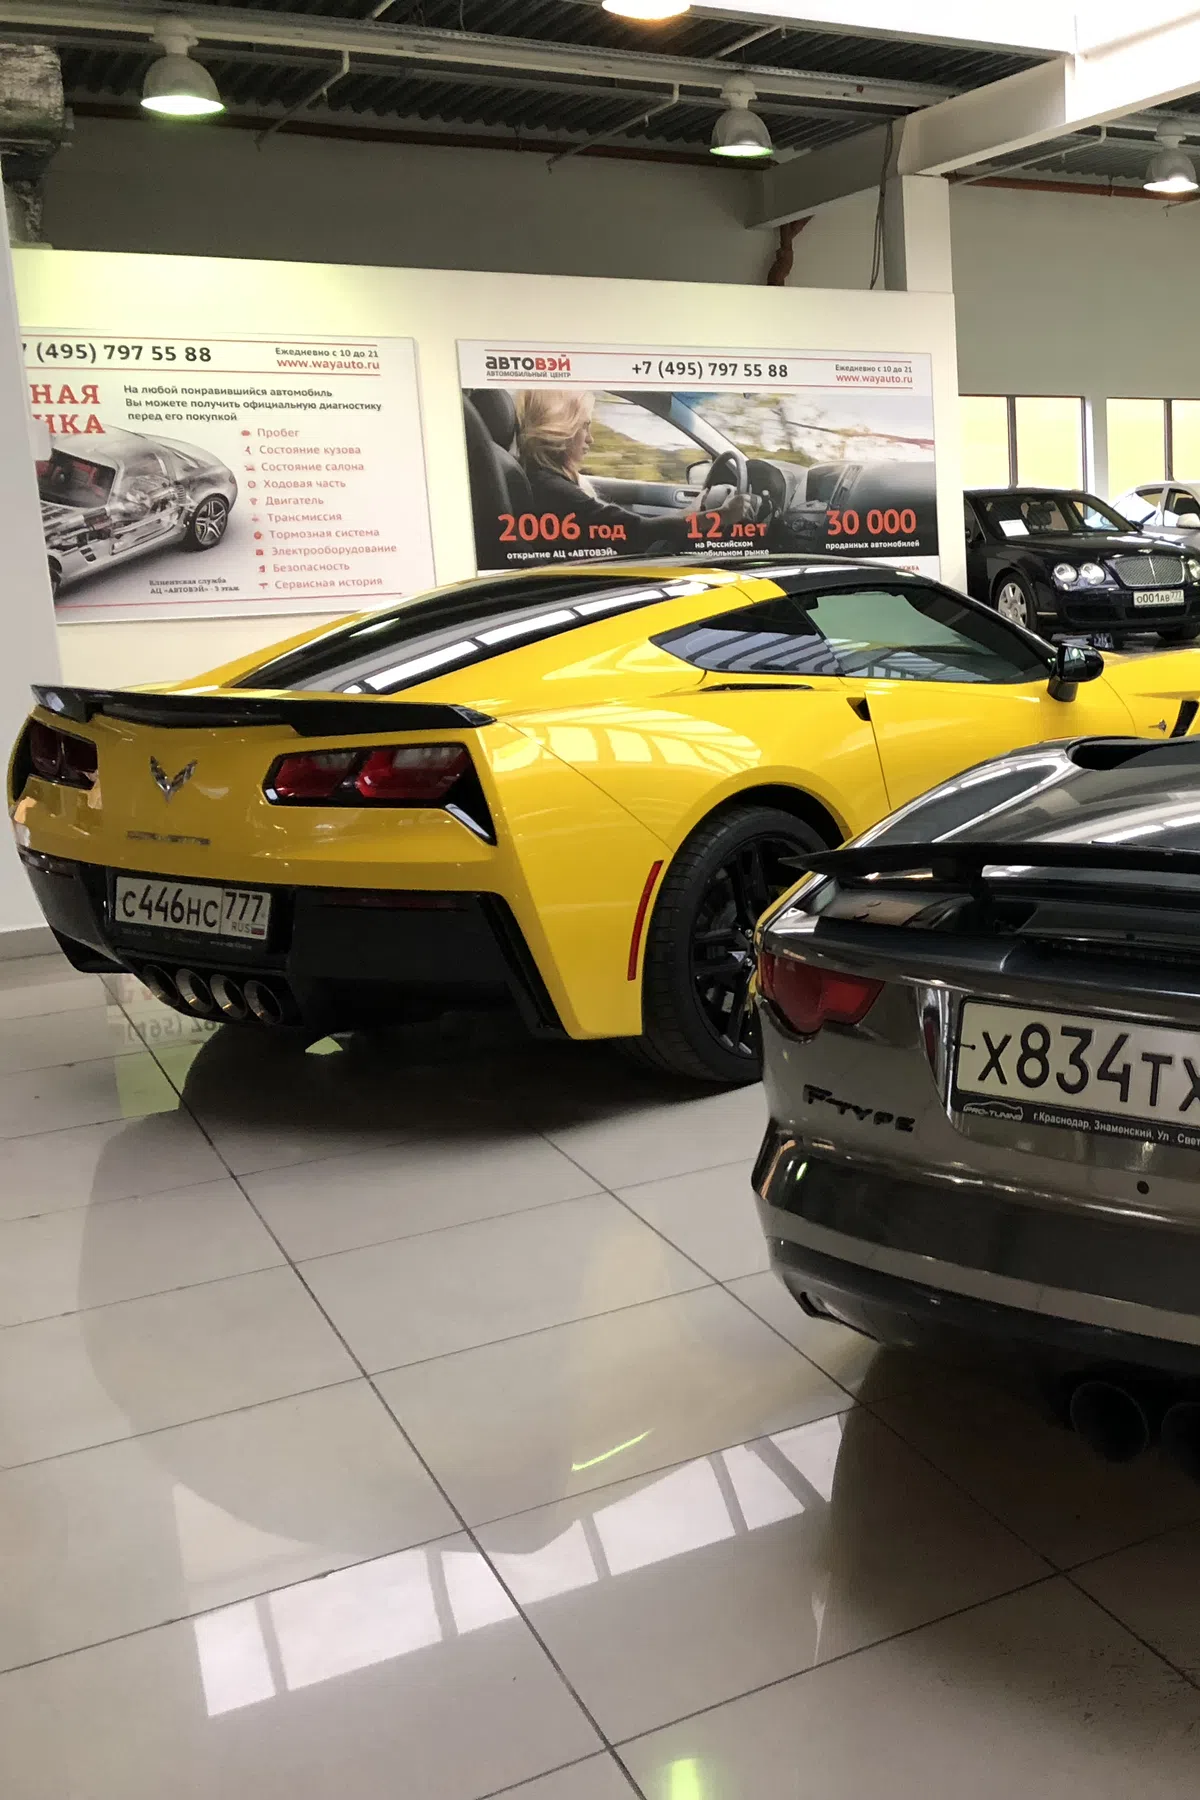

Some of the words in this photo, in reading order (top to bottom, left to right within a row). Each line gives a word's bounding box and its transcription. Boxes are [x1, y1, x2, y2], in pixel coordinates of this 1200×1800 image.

[36, 342, 97, 363] (495)
[103, 344, 143, 361] 797
[152, 346, 177, 361] 55
[184, 347, 212, 362] 88
[275, 347, 330, 357] Ежедневно
[340, 349, 351, 357] 10
[368, 350, 379, 358] 21
[277, 359, 380, 370] www.wayauto.ru
[631, 361, 652, 375] +7
[658, 360, 703, 379] (495)
[708, 363, 738, 377] 797
[743, 363, 763, 377] 55
[768, 364, 788, 378] 88
[835, 364, 876, 373] Ежедневно
[486, 370, 548, 378] АВТОМОБИЛЬНЫЙ
[836, 374, 913, 385] www.wayauto.ru
[29, 384, 101, 404] НАЯ
[123, 385, 139, 394] На
[141, 385, 178, 394] любой
[181, 387, 267, 397] понравившийся
[270, 388, 333, 398] автомобиль
[126, 398, 142, 407] Вы
[145, 400, 188, 408] можете
[190, 400, 241, 410] получить
[243, 400, 317, 411] официальную
[319, 402, 382, 412] диагностику
[128, 412, 163, 422] перед
[165, 413, 184, 422] его
[185, 412, 237, 423] покупкой
[257, 428, 299, 438] Пробег
[259, 445, 320, 454] Состояние
[323, 446, 361, 456] кузова
[261, 462, 322, 471] Состояние
[325, 463, 364, 471] салона
[263, 480, 313, 489] Ходовая
[316, 480, 346, 488] часть
[265, 496, 324, 506] Двигатель
[267, 513, 342, 523] Трансмиссия
[826, 509, 859, 536] 30
[866, 509, 917, 535] 000
[498, 511, 580, 542] 2006
[589, 524, 627, 541] год
[685, 512, 723, 539] 12
[731, 523, 767, 537] лет
[270, 530, 332, 540] Тормозная
[335, 529, 380, 538] система
[706, 540, 754, 548] Российском
[825, 541, 869, 550] проданных
[870, 540, 920, 549] автомобилей
[272, 545, 397, 556] Электрооборудование
[507, 551, 550, 561] открытие
[553, 549, 567, 559] АЦ
[568, 547, 618, 558] «АВТОВЭЙ»
[273, 563, 350, 573] Безопасность
[275, 579, 335, 590] Сервисная
[338, 577, 383, 588] история
[225, 892, 263, 922] 777
[231, 921, 251, 933] RUS
